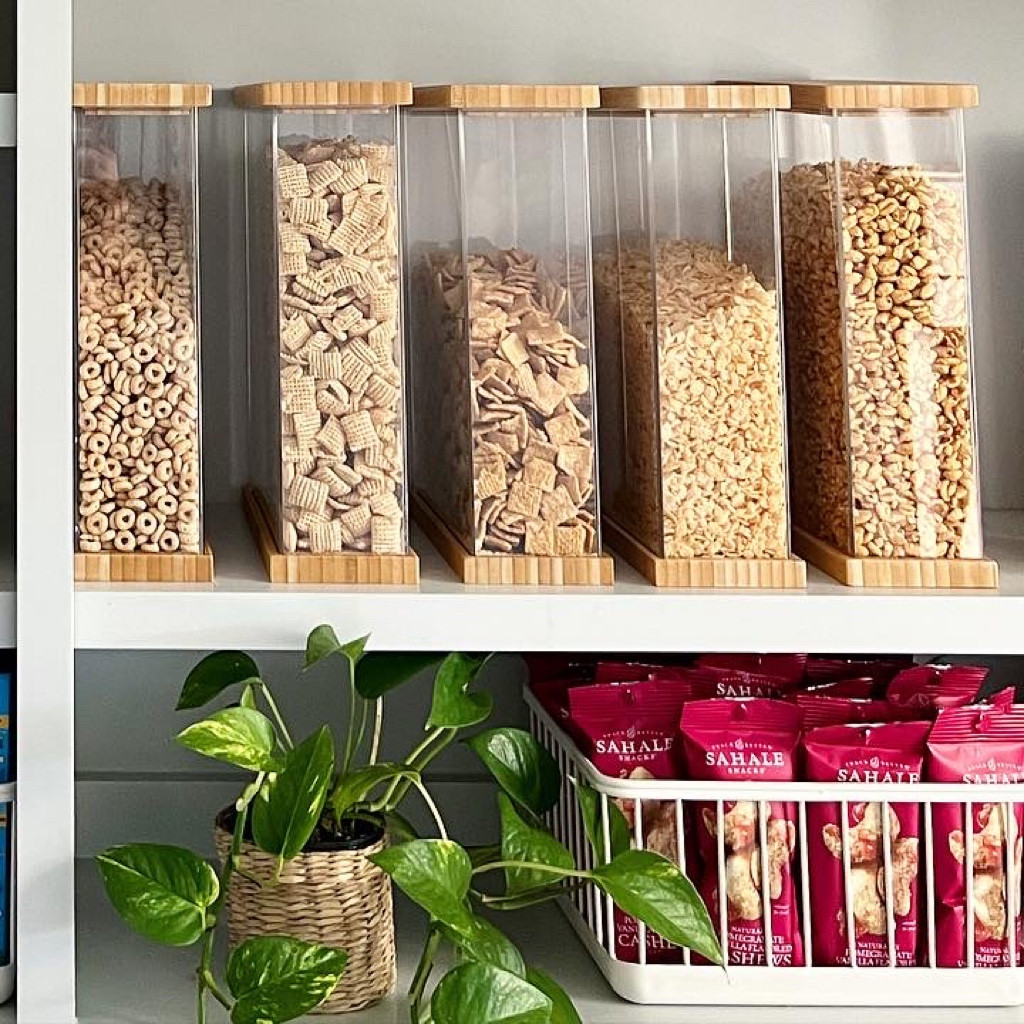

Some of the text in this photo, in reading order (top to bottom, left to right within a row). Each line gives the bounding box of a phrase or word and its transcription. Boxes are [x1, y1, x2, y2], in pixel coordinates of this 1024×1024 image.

[596, 737, 674, 754] SAHALE
[705, 751, 785, 766] SAHALE
[727, 767, 766, 775] SNACKS
[837, 768, 921, 784] SAHALE
